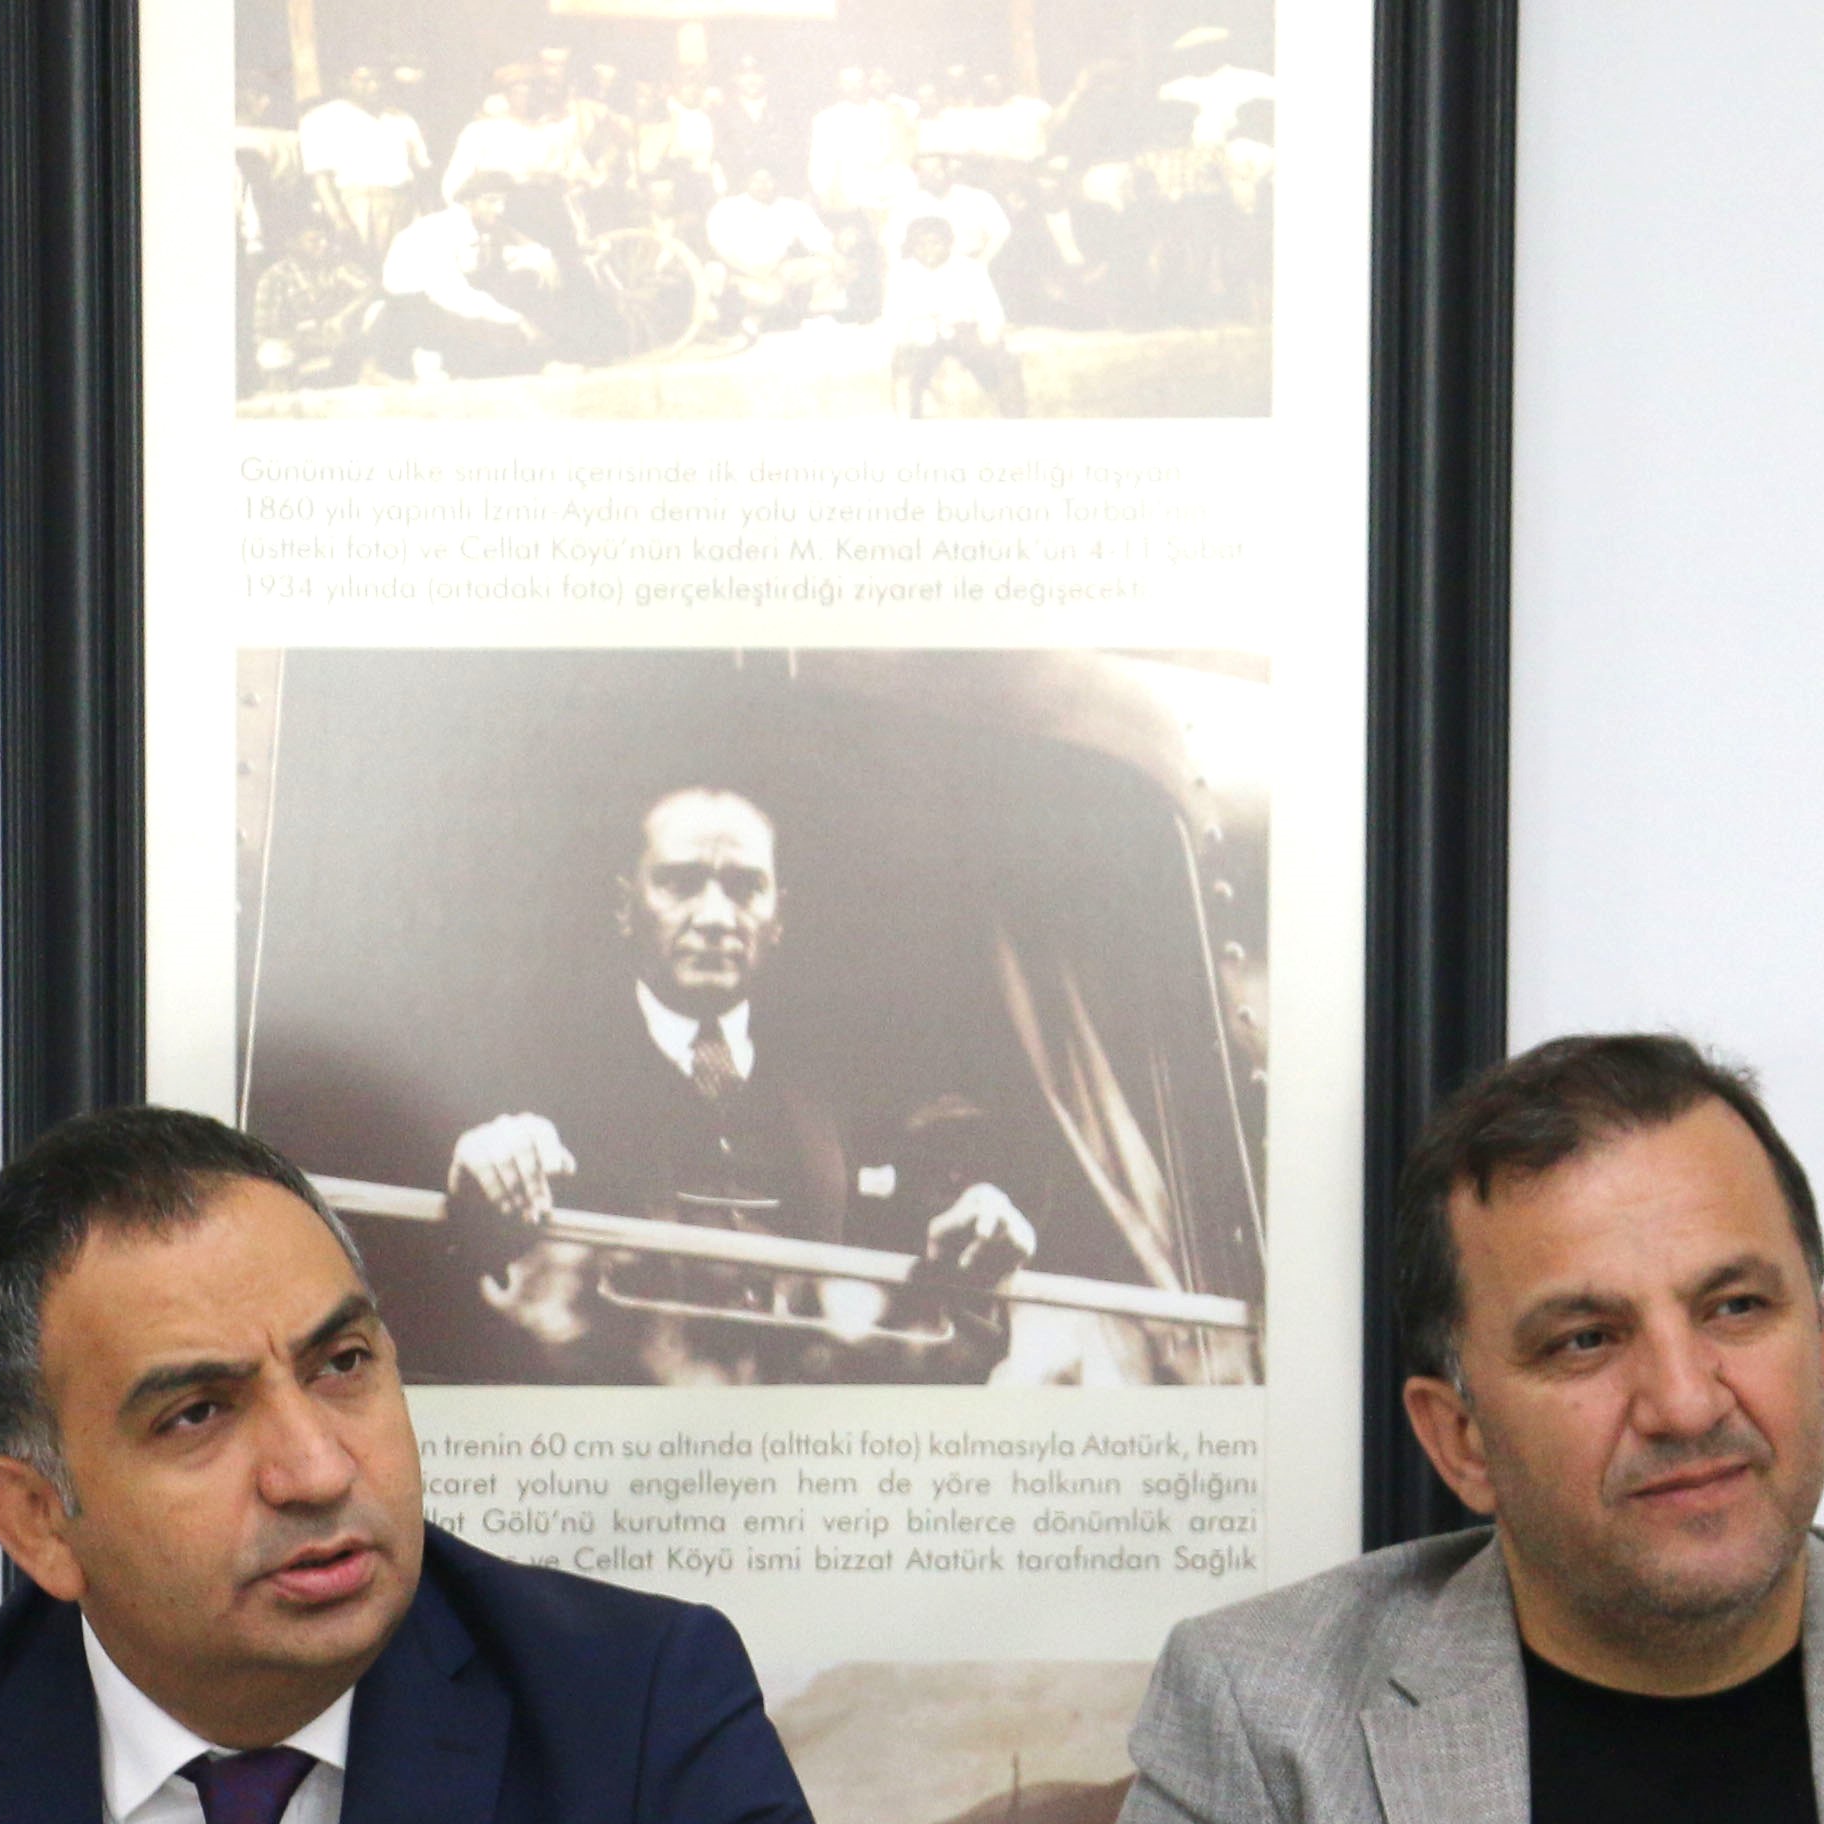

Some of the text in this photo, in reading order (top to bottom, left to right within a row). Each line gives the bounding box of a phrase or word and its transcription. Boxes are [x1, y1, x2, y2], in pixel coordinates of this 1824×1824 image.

[240, 455, 375, 483] Günümüz
[708, 459, 738, 483] ilk
[896, 461, 967, 483] olma
[244, 495, 315, 521] 1860
[325, 497, 361, 526] yılı
[372, 497, 472, 526] yapımlı
[650, 497, 727, 523] demir
[741, 497, 797, 528] yolu
[808, 497, 926, 523] üzerinde
[937, 498, 1051, 523] bulunan
[240, 536, 335, 565] (üstteki
[347, 535, 408, 565] foto)
[419, 544, 448, 560] ve
[460, 535, 540, 560] Cellat
[693, 536, 779, 561] kaderi
[790, 538, 824, 561] M.
[837, 537, 922, 561] Kemal
[245, 574, 314, 599] 1934
[326, 574, 416, 605] yılında
[428, 575, 551, 604] (ortadaki
[563, 574, 624, 606] foto)
[635, 575, 844, 609] gerçekleştirdiği
[853, 577, 944, 608] ziyaret
[953, 577, 984, 600] ile
[446, 1434, 522, 1457] trenin
[530, 1432, 565, 1457] 60
[574, 1441, 614, 1457] cm
[623, 1442, 650, 1457] su
[660, 1432, 753, 1457] altında
[760, 1432, 853, 1462] (alttaki
[859, 1432, 921, 1462] foto)
[930, 1432, 1075, 1463] kalmasıyla
[1082, 1432, 1190, 1461] Atatürk,
[1198, 1432, 1258, 1457] hem
[422, 1470, 1257, 1505] icaret yolunu engelleyen hem de yöre halkının sağlığını
[613, 1508, 726, 1533] kurutma
[743, 1509, 805, 1533] emri
[823, 1509, 890, 1541] verip
[907, 1508, 1016, 1533] binlerce
[1033, 1508, 1172, 1533] dönümlük
[1189, 1508, 1257, 1533] arazi
[573, 1546, 653, 1571] Cellat
[668, 1546, 733, 1577] Köyü
[746, 1547, 801, 1571] ismi
[814, 1546, 896, 1571] bizzat
[905, 1546, 1004, 1571] Atatürk
[1017, 1545, 1160, 1571] tarafından
[1174, 1545, 1257, 1577] Sağlık
